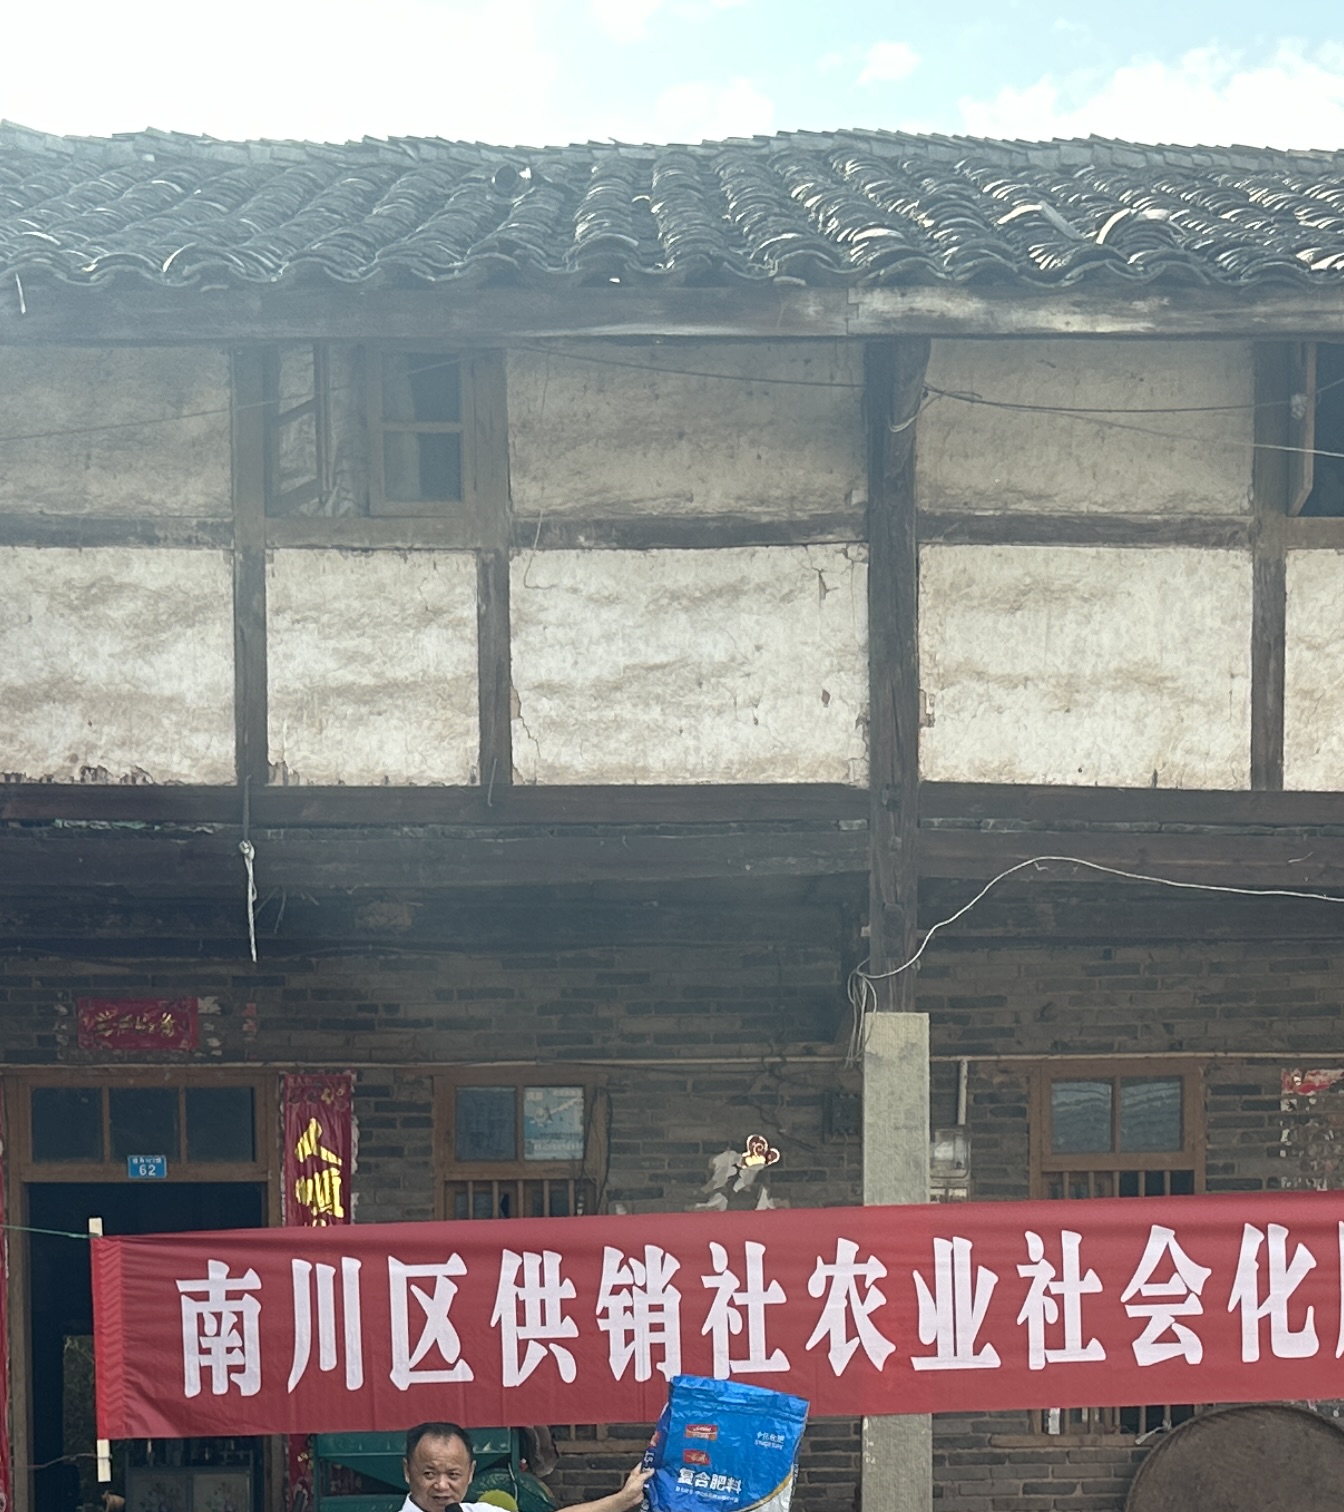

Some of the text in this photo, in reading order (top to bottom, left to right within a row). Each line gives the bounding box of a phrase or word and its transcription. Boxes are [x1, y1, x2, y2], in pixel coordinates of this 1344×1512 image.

[139, 1164, 156, 1177] 62
[677, 1467, 742, 1495] 复合肥料
